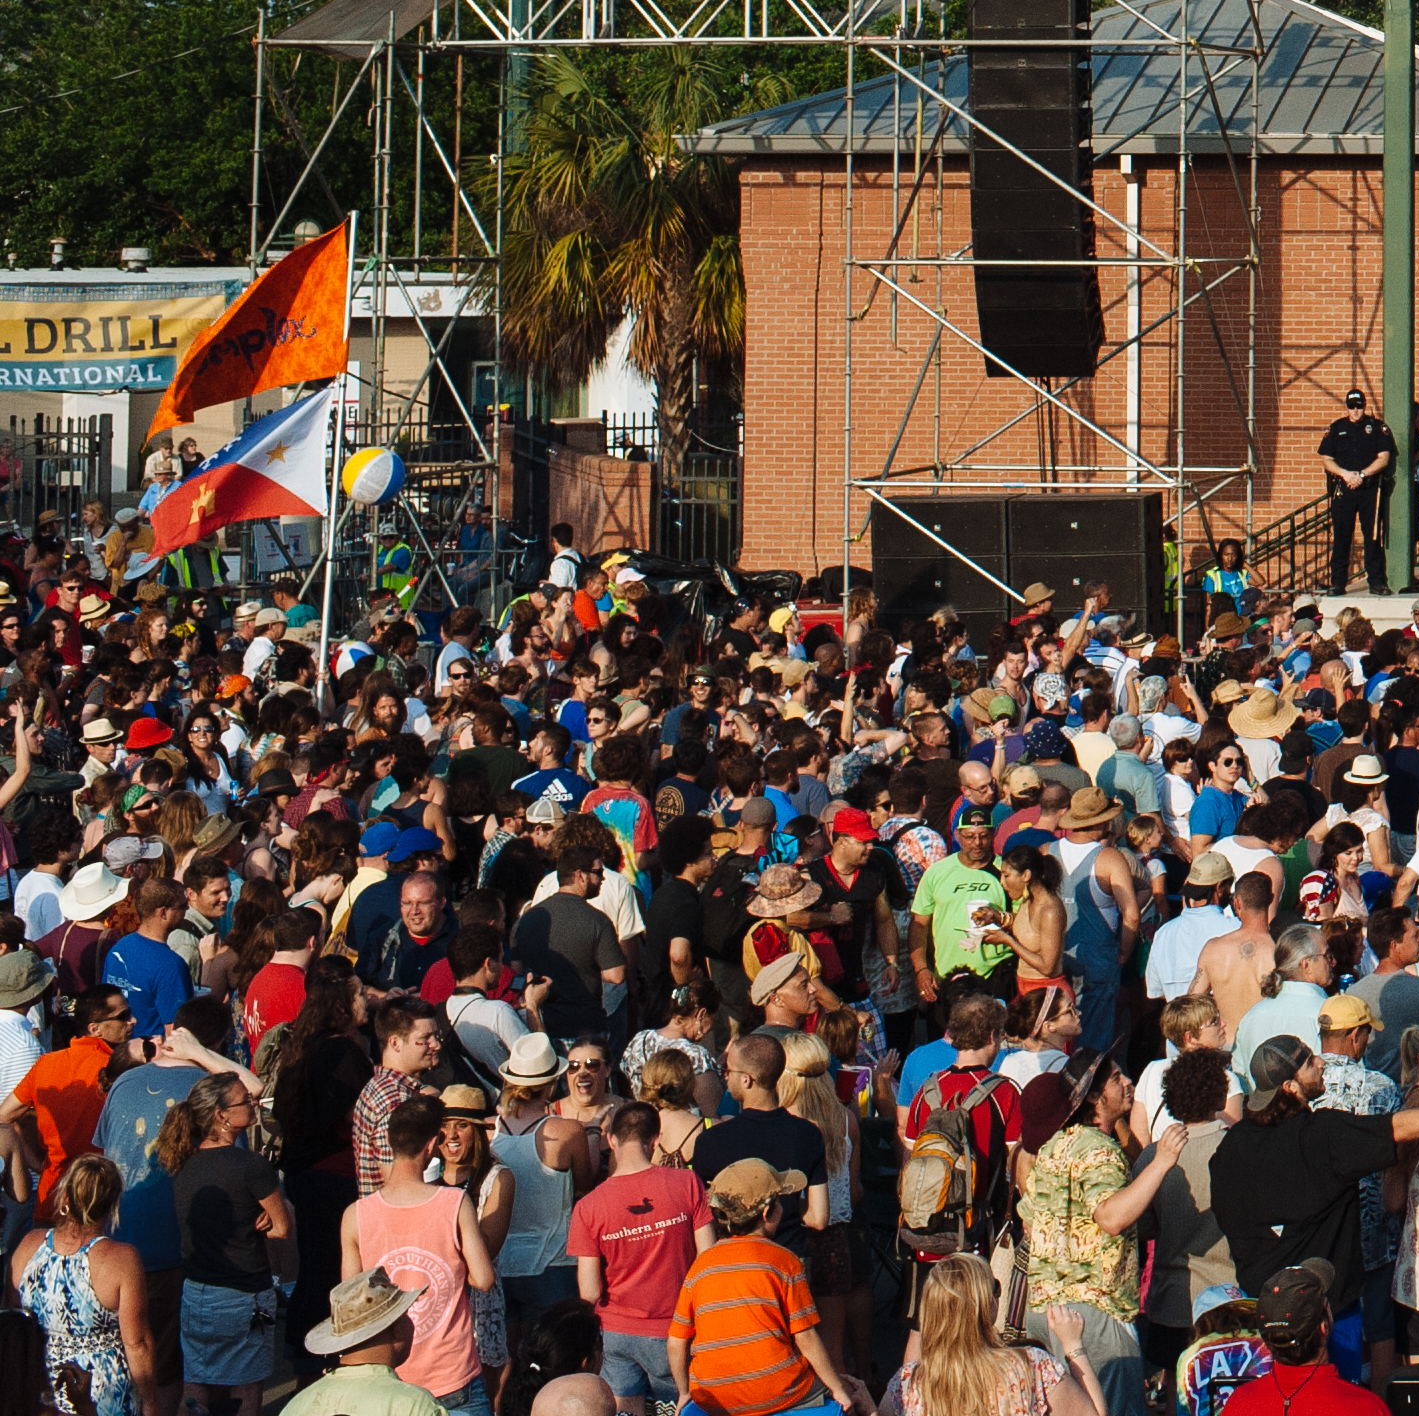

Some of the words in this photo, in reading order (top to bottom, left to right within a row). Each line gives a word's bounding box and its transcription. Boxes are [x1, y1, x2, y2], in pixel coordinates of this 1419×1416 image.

[24, 315, 177, 354] DRILL
[953, 882, 991, 894] F50
[601, 1224, 653, 1242] southern
[654, 1211, 688, 1230] marsh
[387, 1252, 449, 1289] SOUTHERN
[416, 1295, 448, 1335] MPANY
[1194, 1350, 1232, 1390] LA
